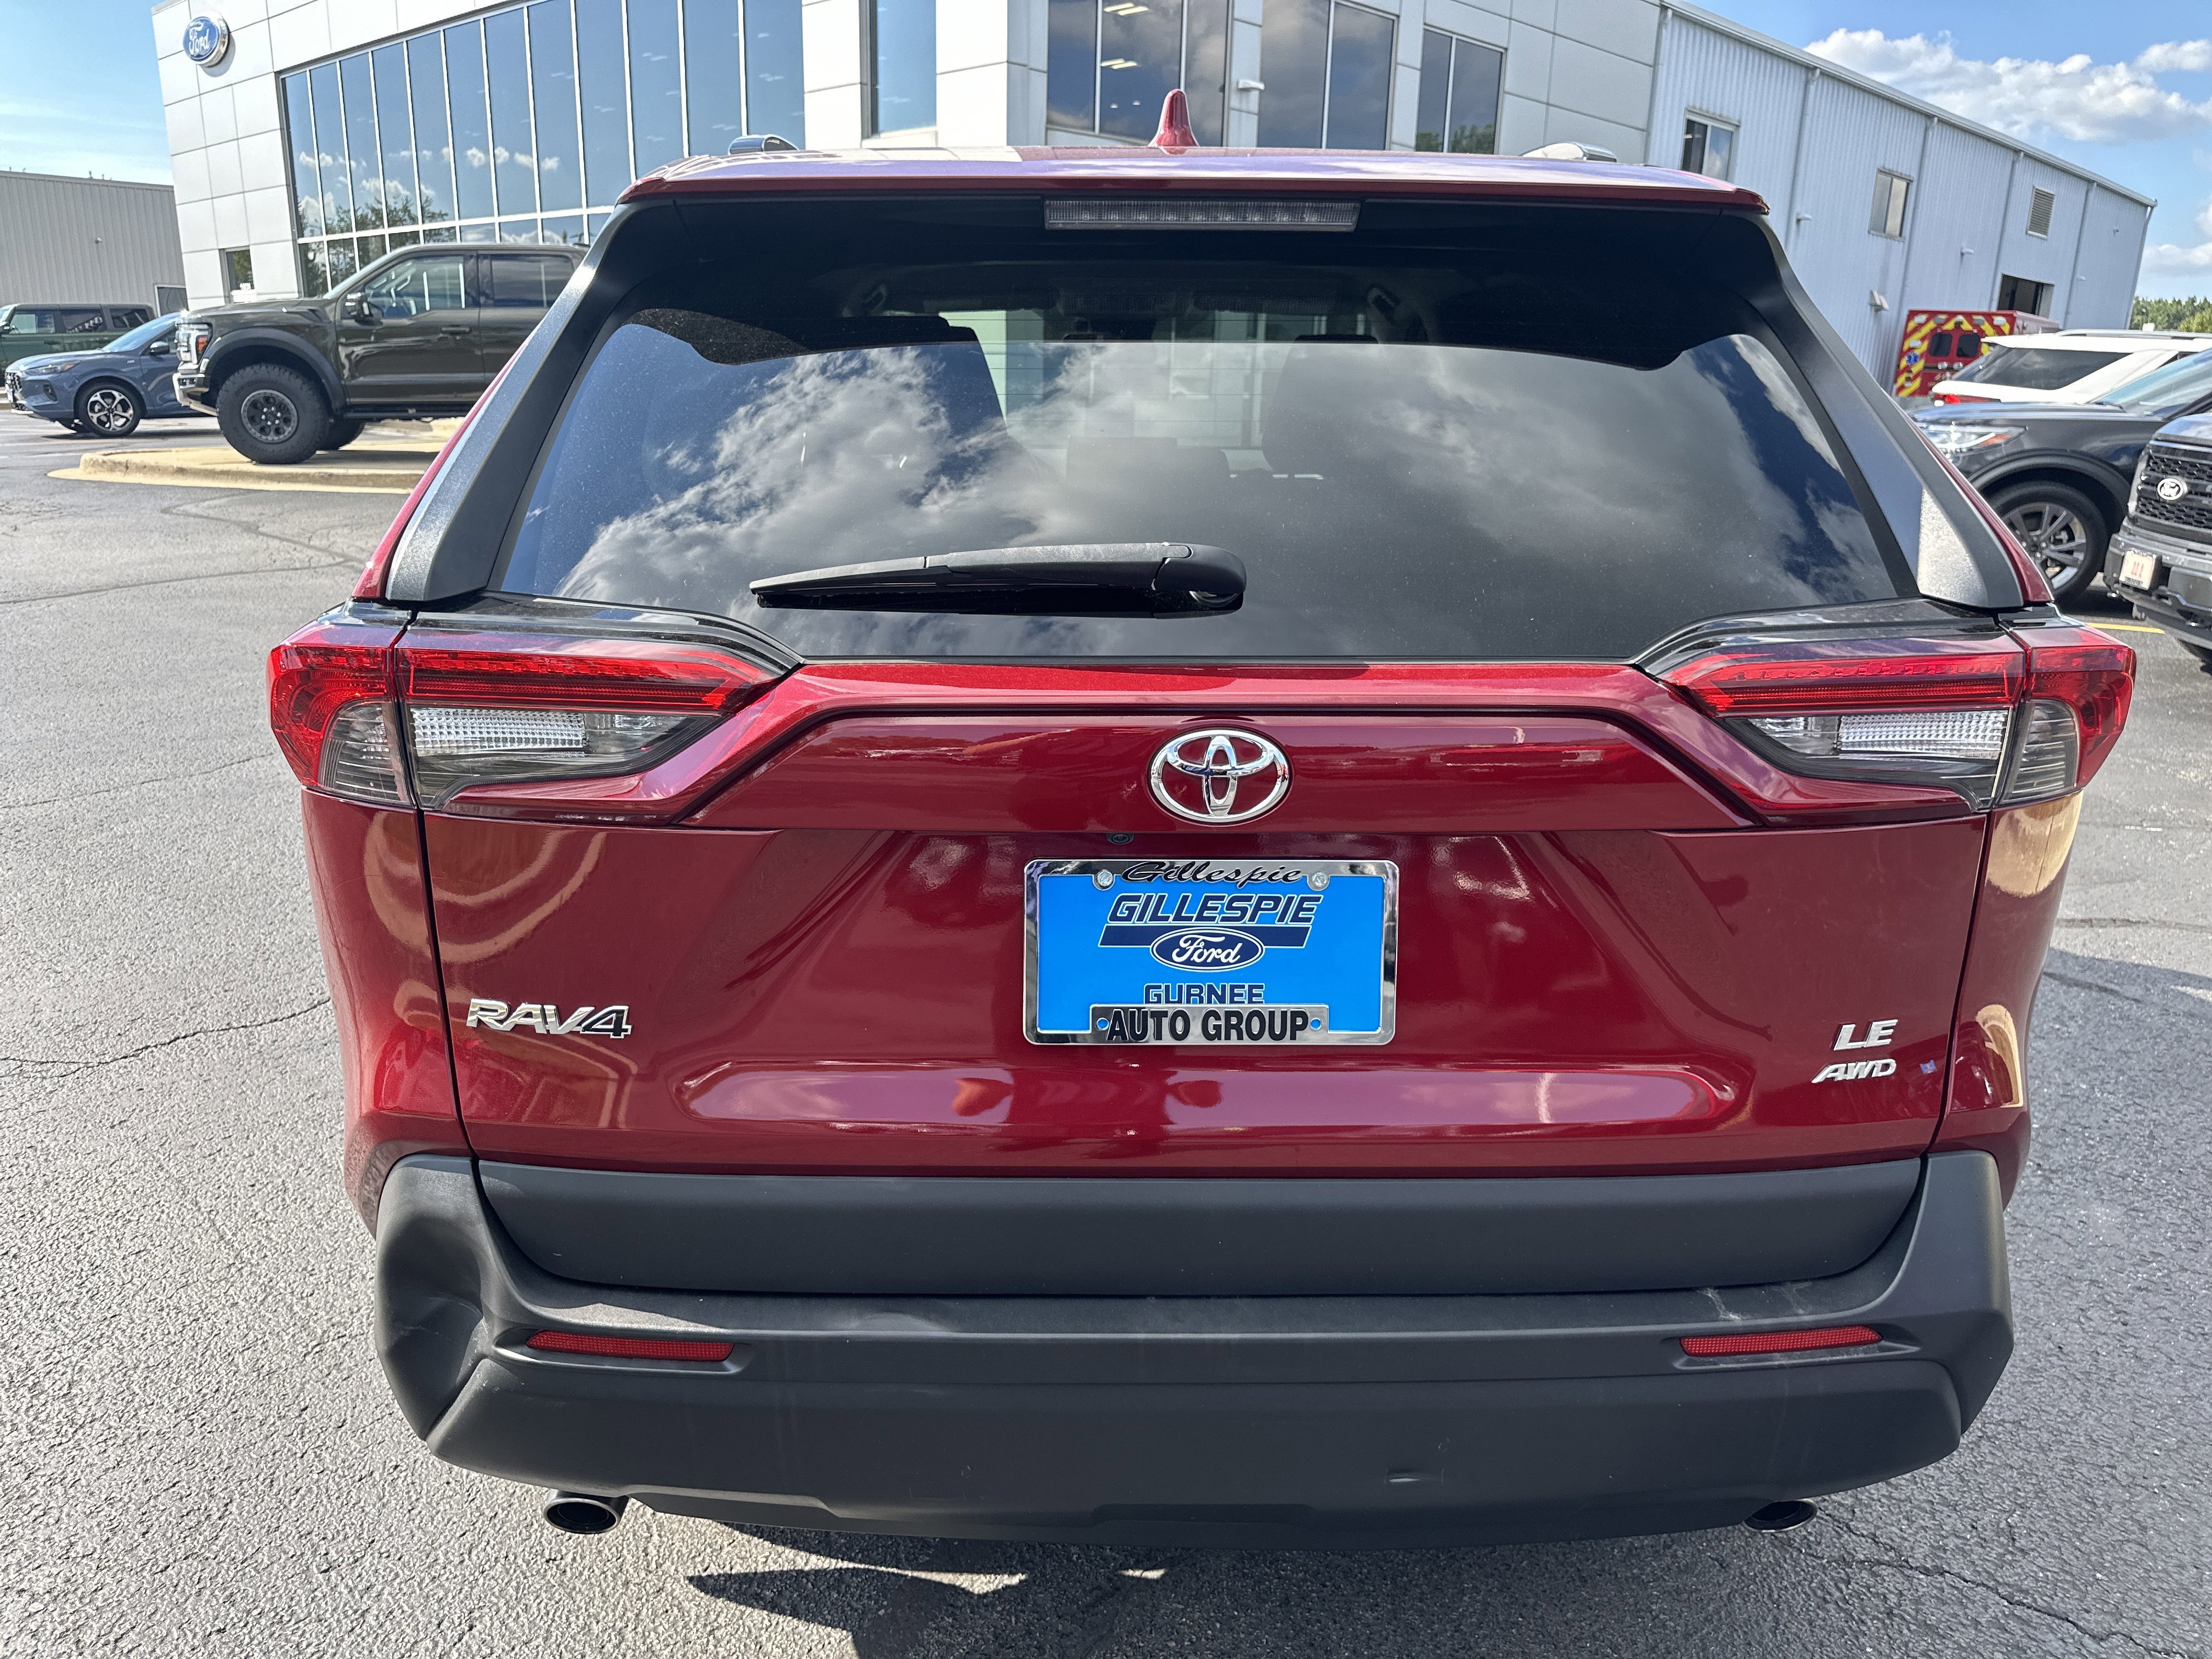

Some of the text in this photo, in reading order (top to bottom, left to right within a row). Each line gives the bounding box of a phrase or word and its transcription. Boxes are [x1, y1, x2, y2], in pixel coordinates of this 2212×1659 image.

[189, 21, 211, 55] Ford
[1121, 861, 1302, 889] Gillespie
[1107, 894, 1323, 924] GILLESPIE
[1172, 936, 1242, 963] Ford
[1144, 983, 1265, 1004] GURNEE
[466, 998, 631, 1039] RAV4
[1107, 1009, 1308, 1040] AUTO GROUP
[1833, 1019, 1898, 1051] LE
[1811, 1058, 1897, 1084] AWD
